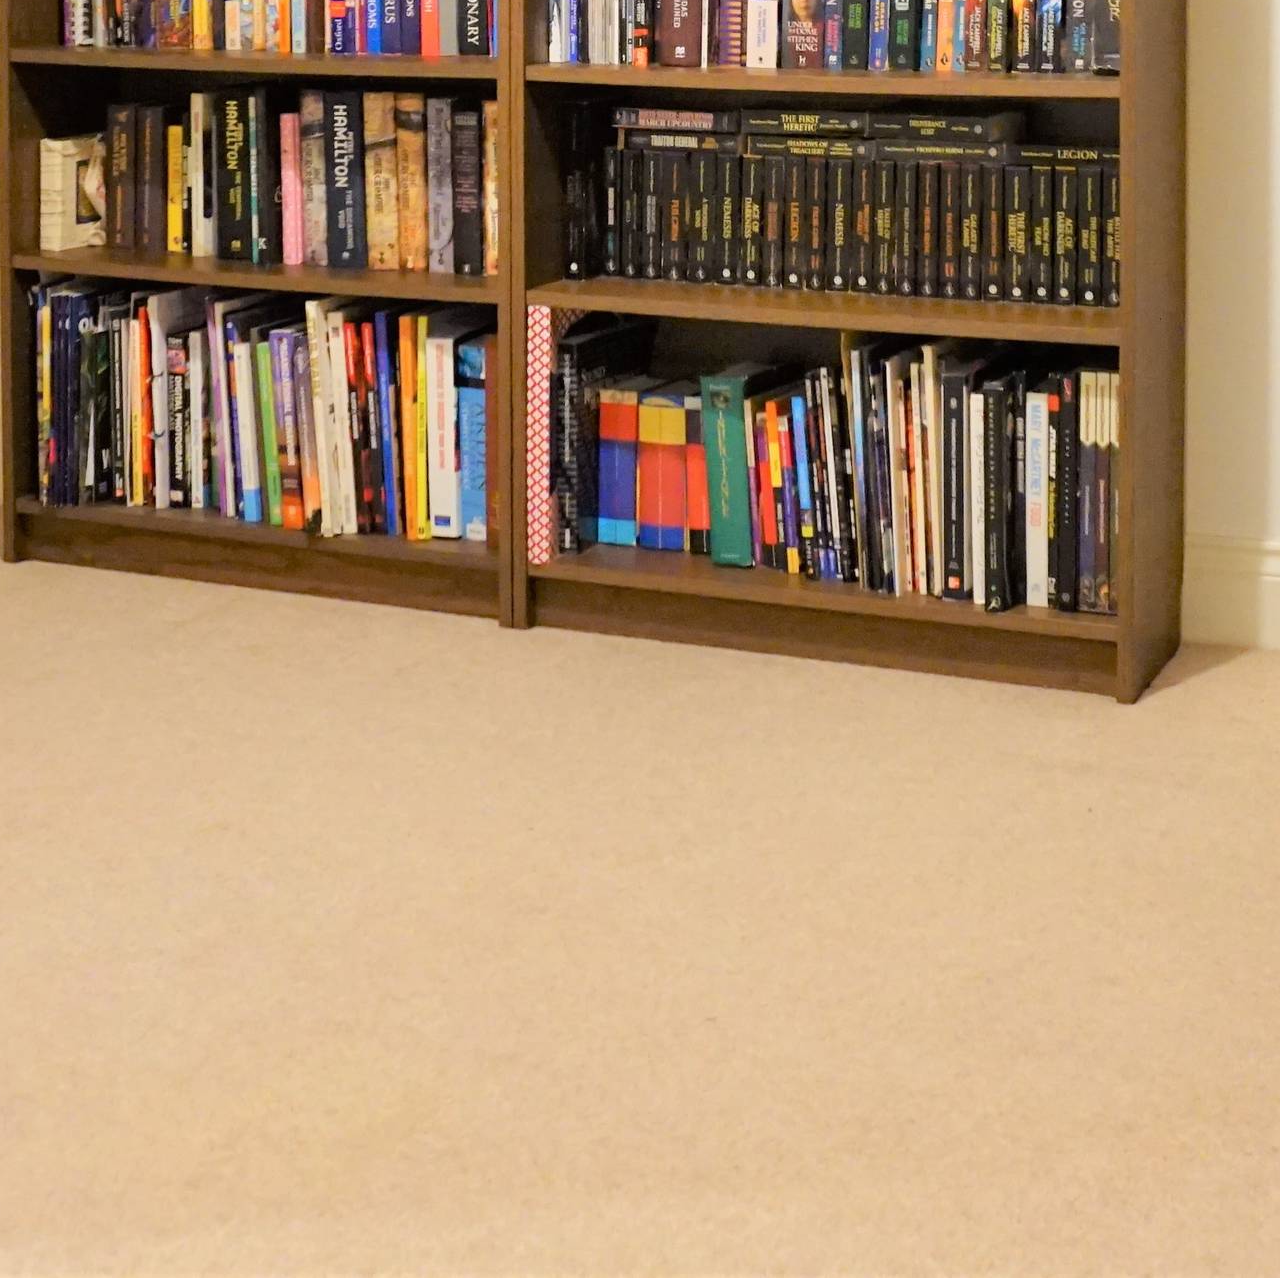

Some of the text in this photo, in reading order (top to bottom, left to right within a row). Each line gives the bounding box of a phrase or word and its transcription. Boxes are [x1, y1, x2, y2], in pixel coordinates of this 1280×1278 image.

[795, 44, 818, 52] KING
[226, 101, 238, 170] HAMILTON
[333, 105, 348, 188] HAMILTON
[723, 197, 732, 239] NEMESIS
[834, 203, 844, 246] NEMESIS
[174, 376, 184, 480] DIGITAL PHOTOGRAPHY
